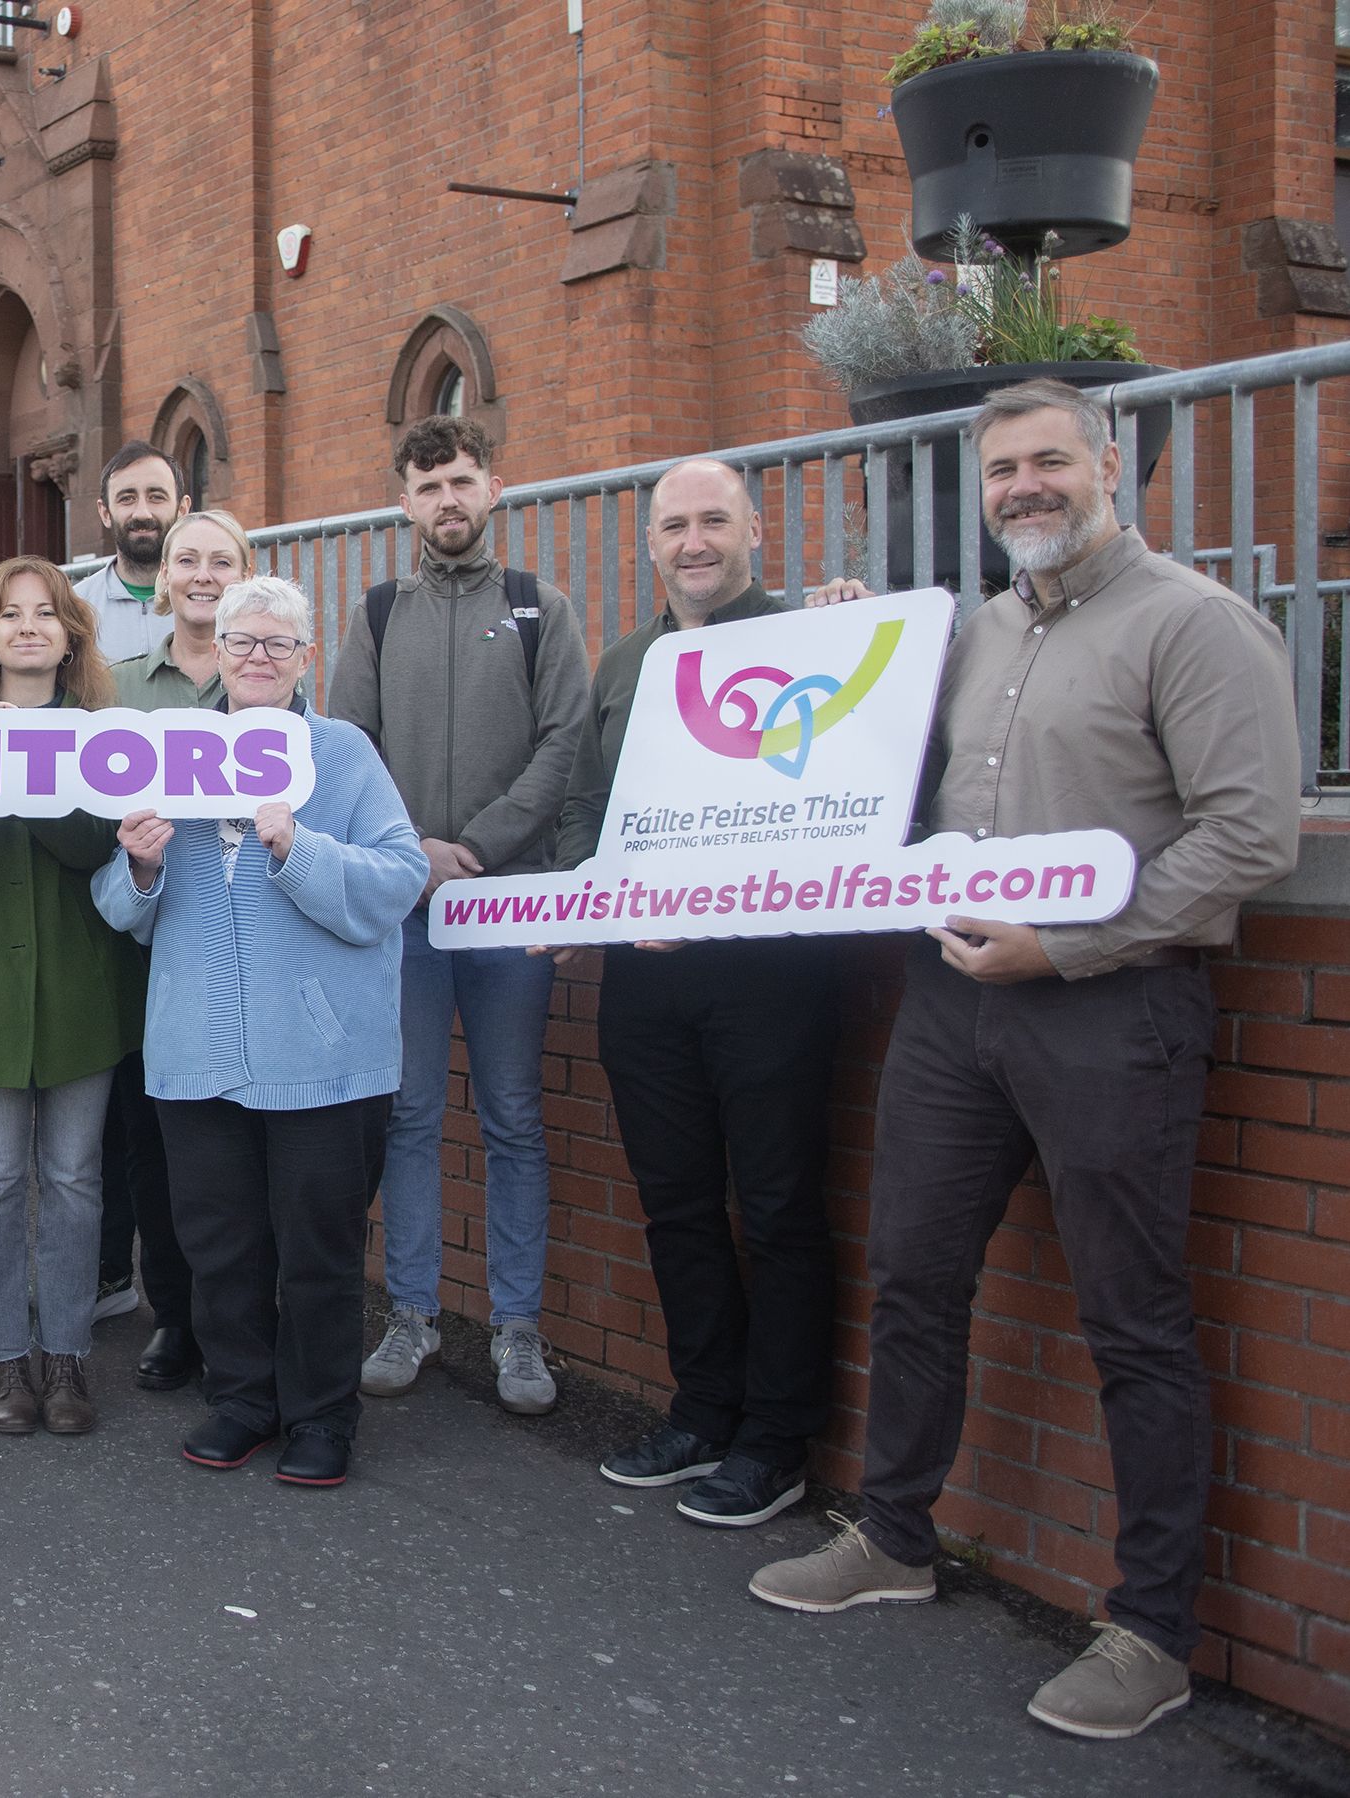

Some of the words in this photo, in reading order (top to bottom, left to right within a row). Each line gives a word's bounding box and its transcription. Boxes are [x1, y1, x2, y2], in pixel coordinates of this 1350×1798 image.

[620, 806, 695, 837] Fáilte
[699, 801, 796, 830] Feirste
[803, 791, 885, 821] Thiar
[624, 835, 699, 853] PROMOTING
[700, 832, 739, 847] WEST
[740, 827, 800, 844] BELFAST
[802, 823, 867, 840] TOURISM
[443, 862, 1097, 926] www.visitwestbelfast.com
